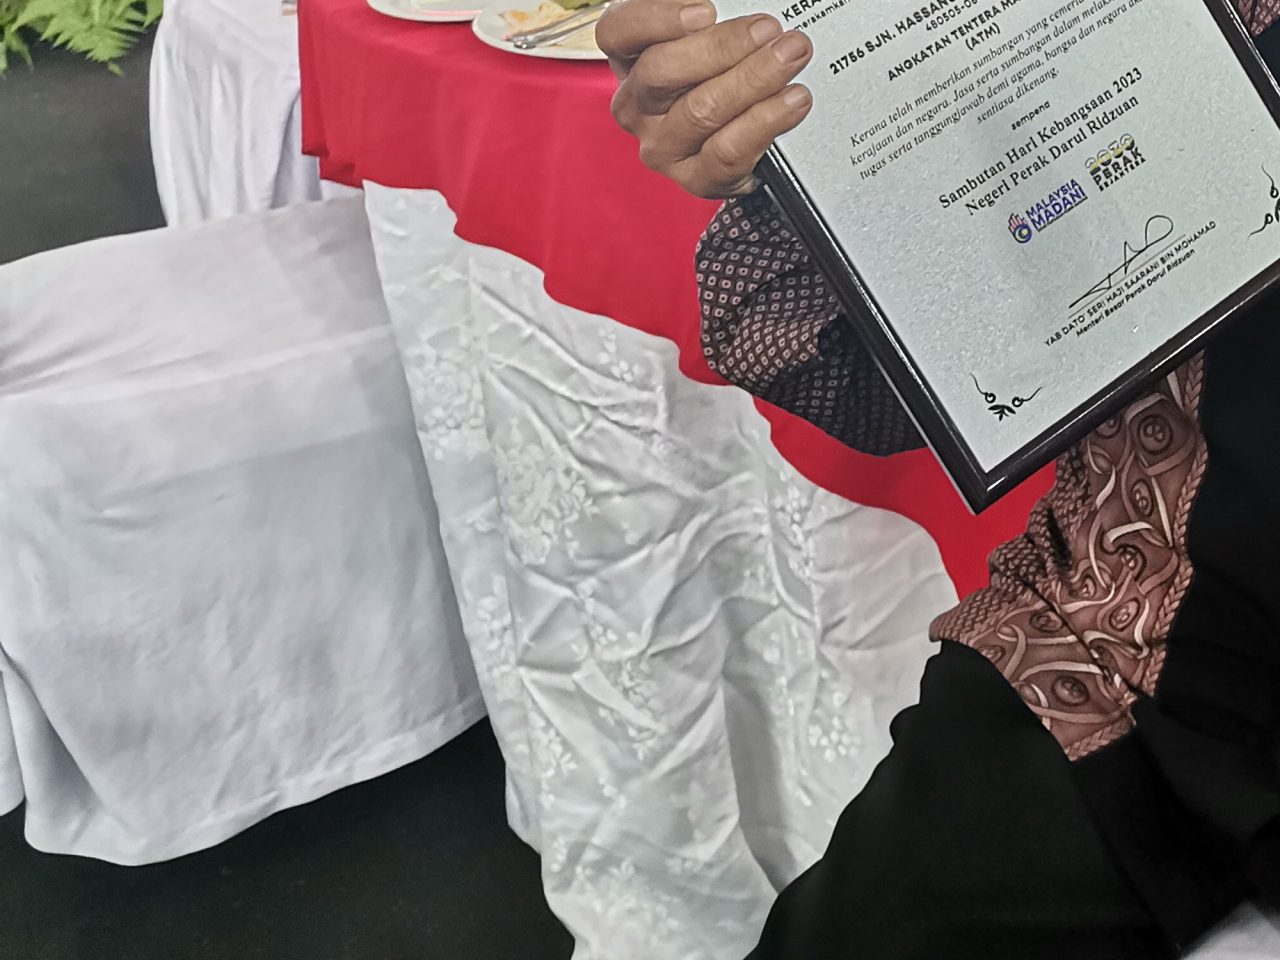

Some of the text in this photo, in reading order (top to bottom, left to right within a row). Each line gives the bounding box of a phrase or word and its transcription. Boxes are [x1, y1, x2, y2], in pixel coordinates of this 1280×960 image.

[864, 29, 896, 52] SJN.
[888, 34, 952, 81] ANGKATAN
[950, 5, 1001, 40] TENTERA
[965, 21, 1000, 51] (ATM)
[850, 119, 887, 147] Kerana
[888, 101, 913, 123] telah
[914, 66, 971, 107] memberikan
[972, 32, 1024, 70] sumbangan
[1025, 17, 1049, 40] yang
[850, 134, 894, 166] kerajaan
[895, 121, 914, 138] dan
[953, 83, 975, 102] Jasa
[976, 67, 999, 87] serta
[1000, 33, 1052, 71] sumbangan
[1053, 15, 1080, 38] dalam
[859, 158, 886, 179] tugas
[888, 141, 913, 161] serta
[913, 93, 985, 145] tanggungjawab
[986, 77, 1009, 99] demi
[1044, 35, 1077, 61] bangsa
[1078, 24, 1095, 40] dan
[1096, 3, 1127, 28] negara
[977, 95, 1014, 124] sentiasa
[938, 66, 1142, 208] Sambutan Hari Kebangsaan 2023
[1011, 100, 1050, 130] sempena
[964, 178, 1011, 215] Negeri
[1009, 155, 1050, 186] Perak
[1048, 127, 1087, 160] Darul
[1085, 96, 1139, 135] Ridzuan
[1085, 132, 1136, 176] 2030
[1092, 146, 1143, 186] PERAK
[1025, 178, 1080, 218] MALAYSIA
[1030, 186, 1086, 227] MADANI
[1044, 331, 1062, 346] YAB
[1086, 300, 1105, 317] SERI
[1105, 286, 1125, 303] HAJI
[1124, 261, 1159, 289] SAARANI
[1159, 250, 1174, 264] BIN
[1174, 220, 1216, 253] MOHAMAD
[1076, 311, 1104, 337] Menteri
[1124, 283, 1146, 302] Perak
[1146, 267, 1166, 286] Darul
[1166, 248, 1195, 272] Ridzuan
